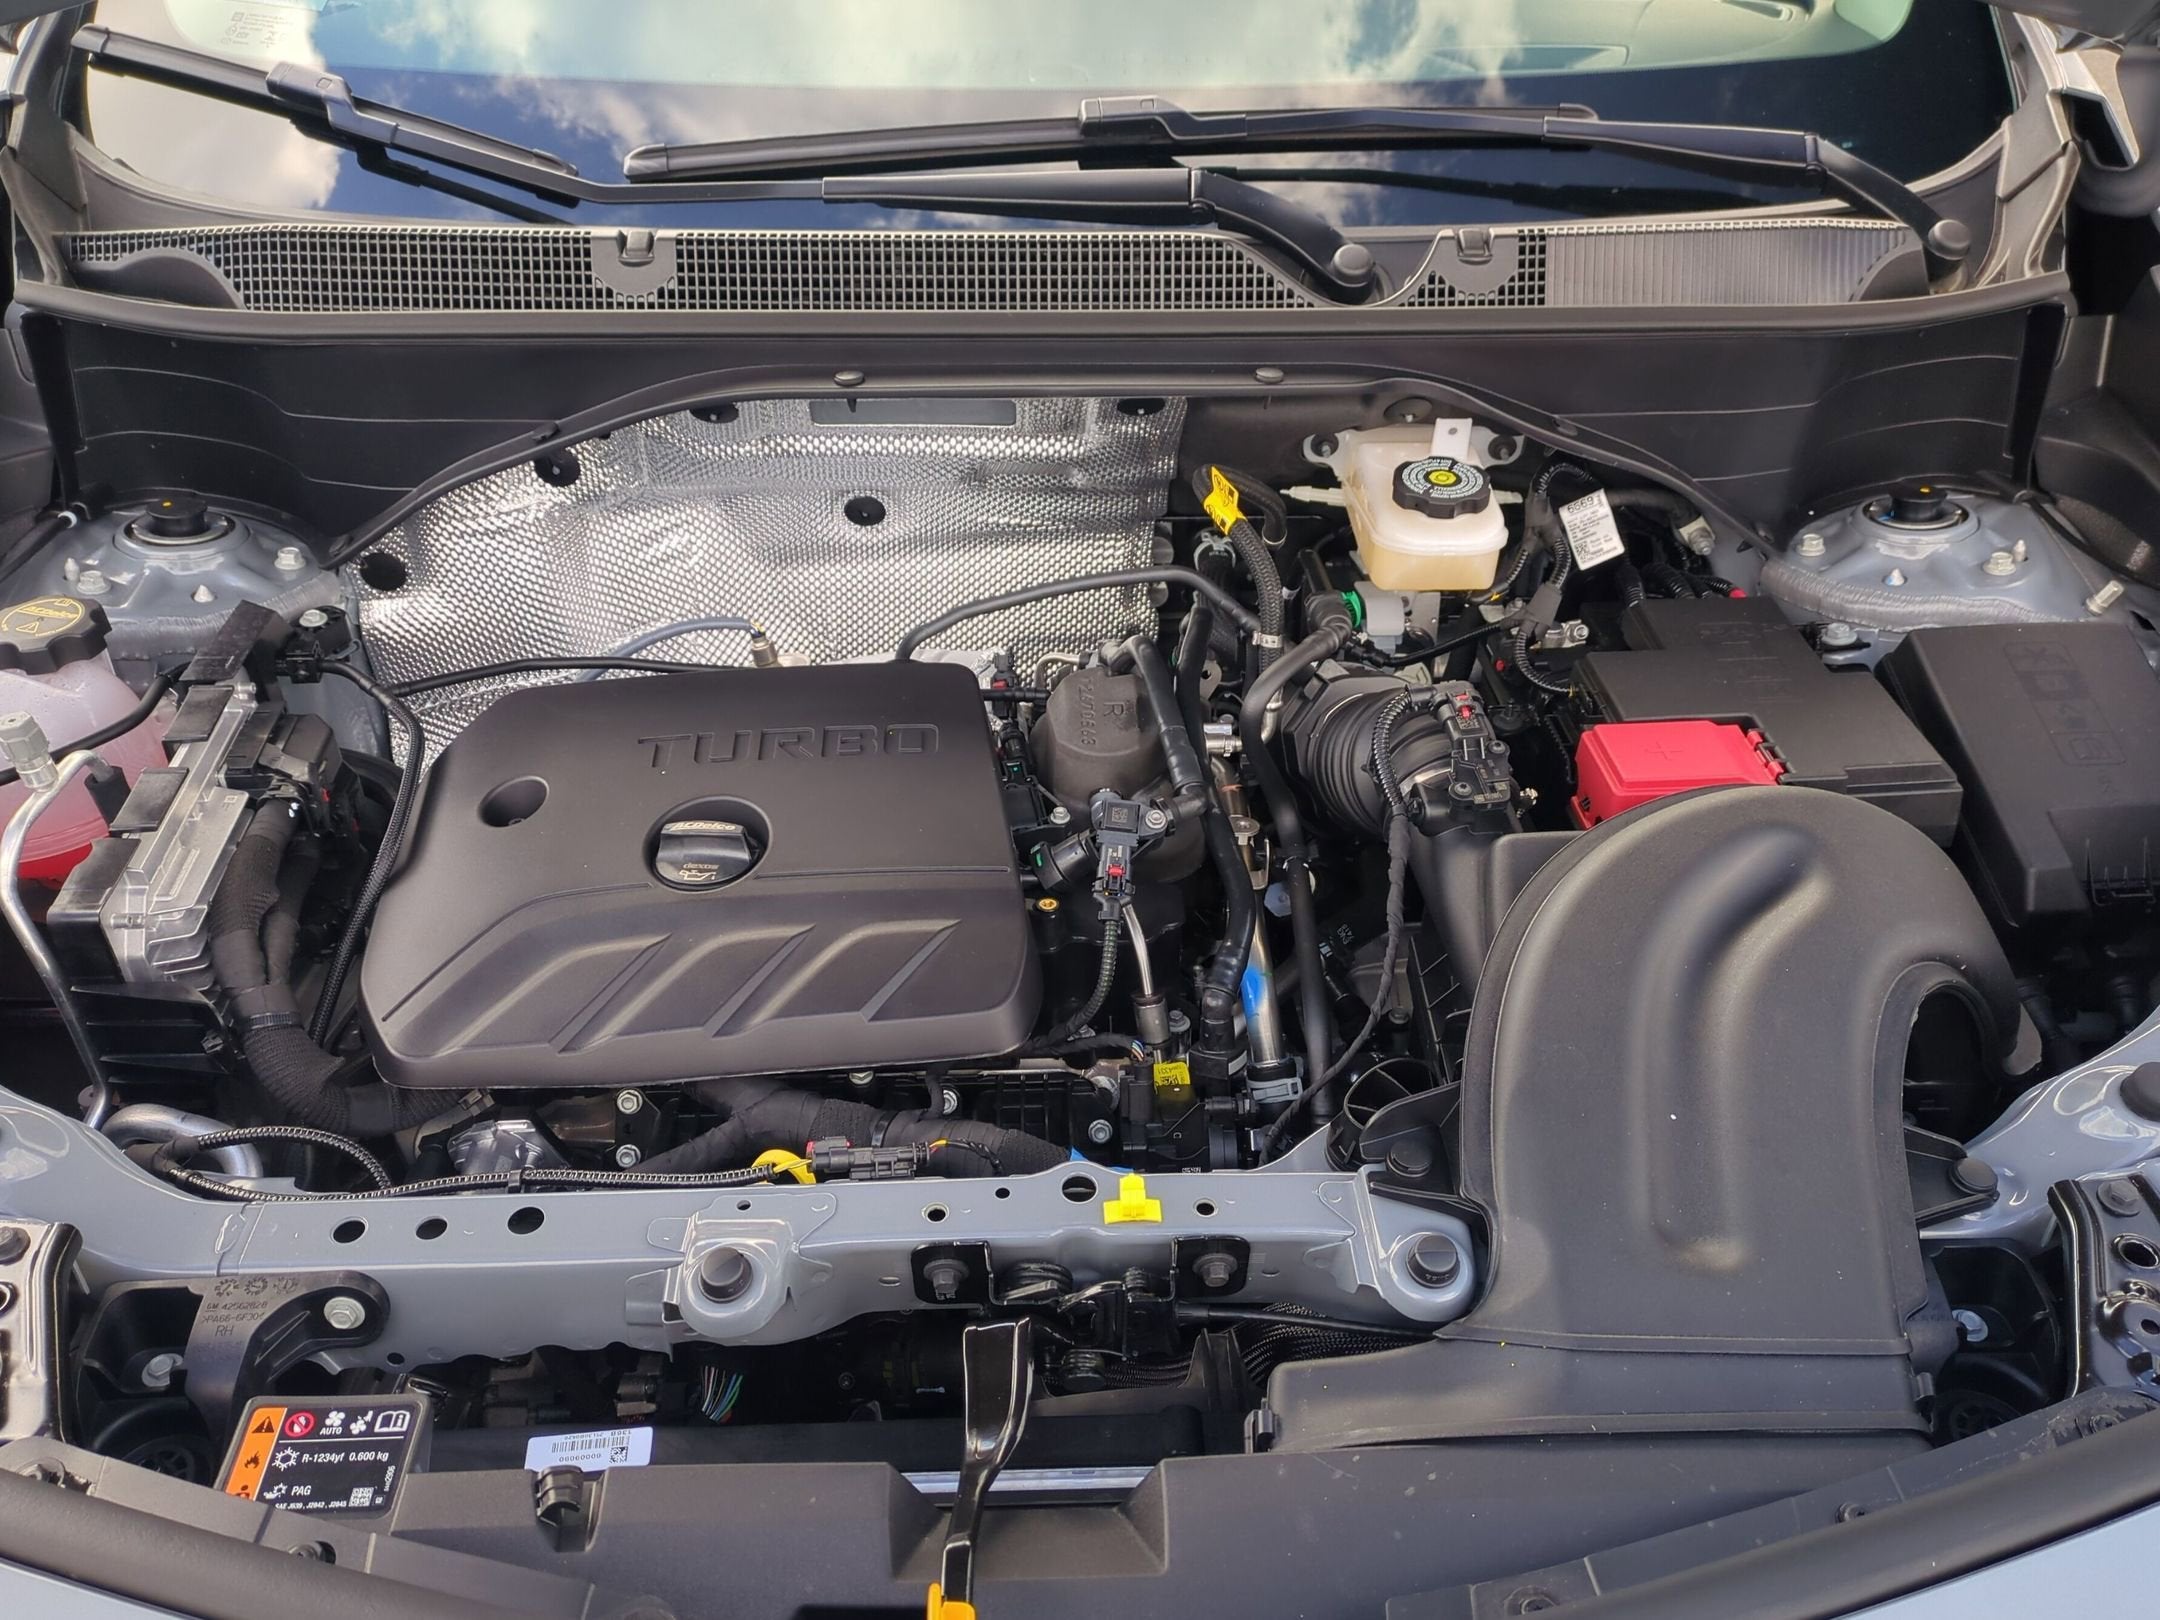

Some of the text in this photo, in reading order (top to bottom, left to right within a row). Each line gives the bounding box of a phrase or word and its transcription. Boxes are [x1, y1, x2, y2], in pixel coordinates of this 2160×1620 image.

[637, 723, 939, 768] TURBO
[671, 821, 736, 832] ACDelco
[682, 862, 720, 870] dexos
[214, 1325, 235, 1337] RH
[319, 1426, 343, 1435] AUTO
[301, 1451, 389, 1463] R-1234yf 0.600 kg
[291, 1486, 312, 1496] PAG
